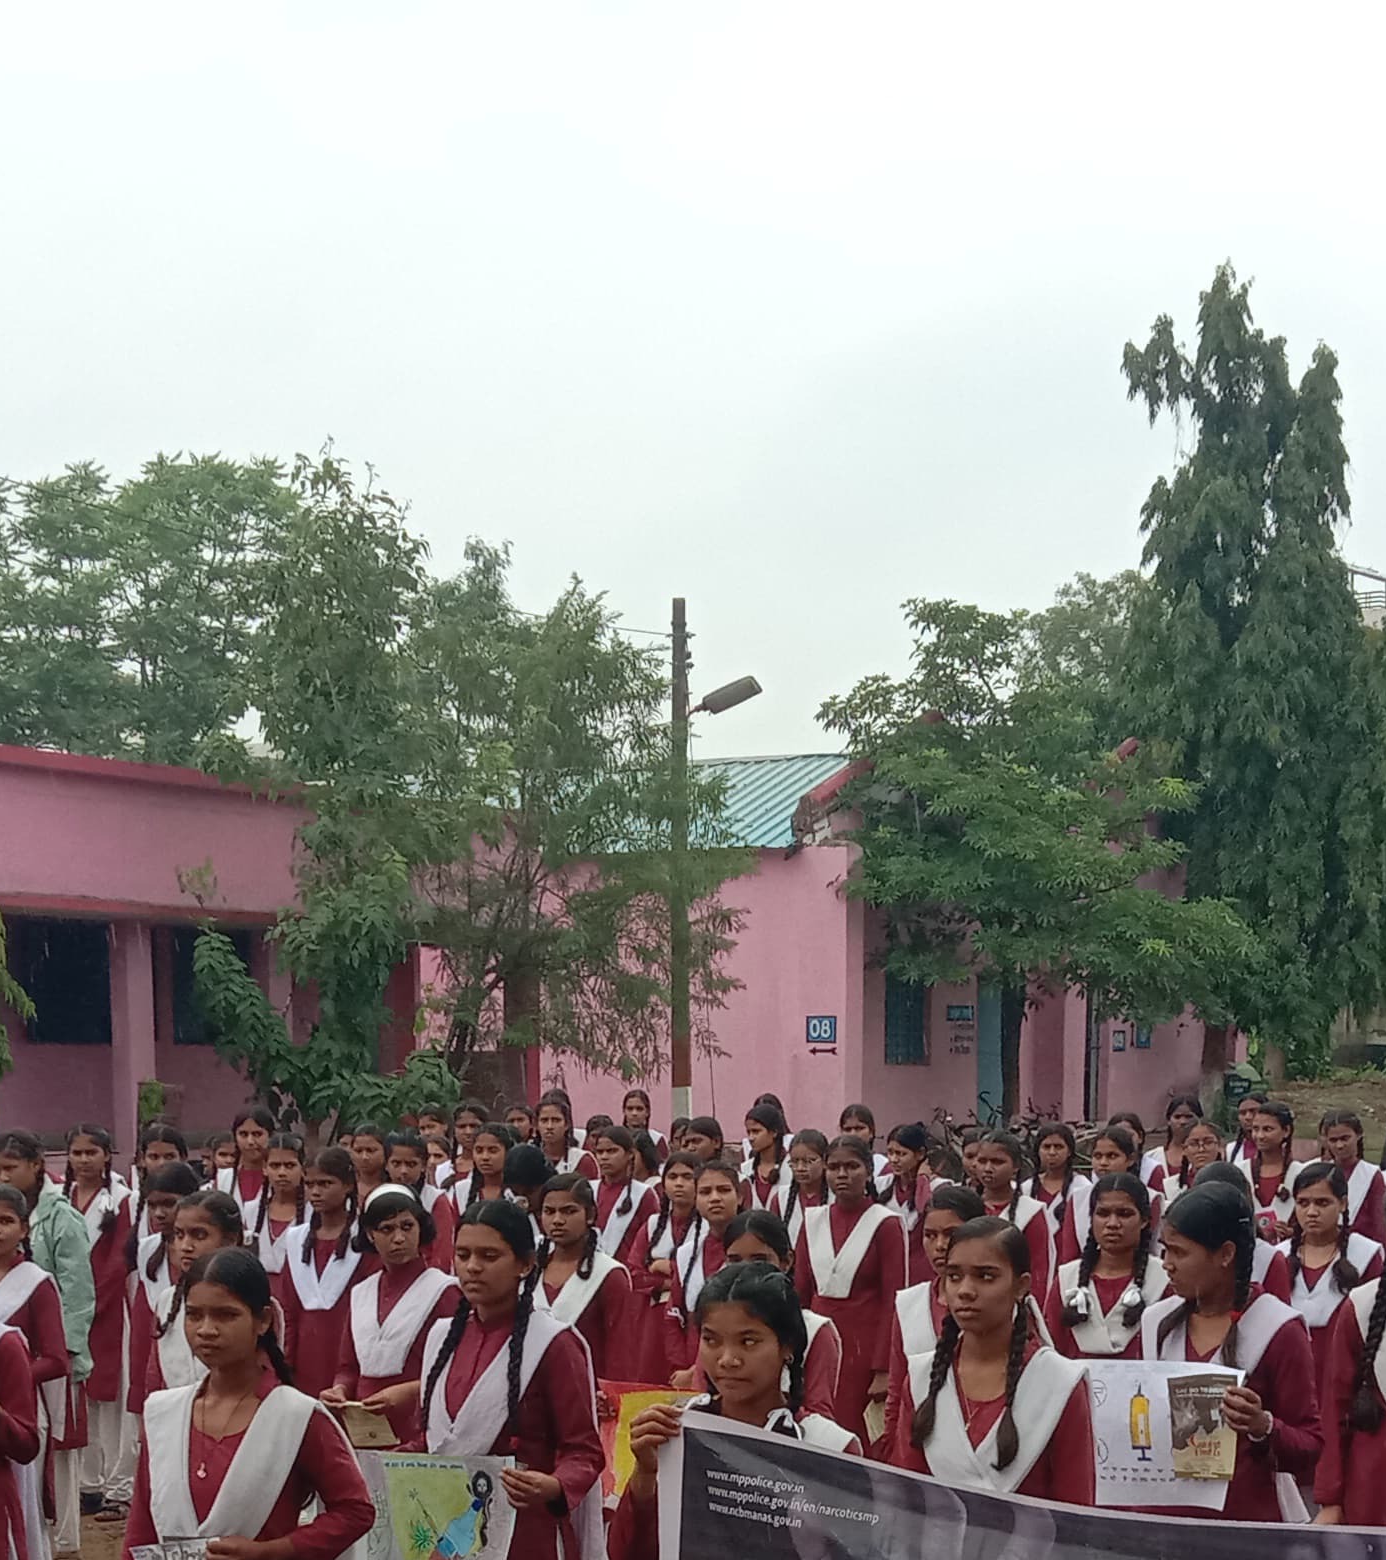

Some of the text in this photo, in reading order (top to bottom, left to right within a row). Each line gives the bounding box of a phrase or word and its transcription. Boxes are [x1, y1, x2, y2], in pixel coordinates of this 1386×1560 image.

[809, 1020, 831, 1038] 08
[706, 1469, 805, 1493] www.mppolice.gov.in
[707, 1485, 879, 1526] www.mppolice.gov.in/en/narcoticsmp
[708, 1502, 803, 1528] www.ncbmanas.gov.in
